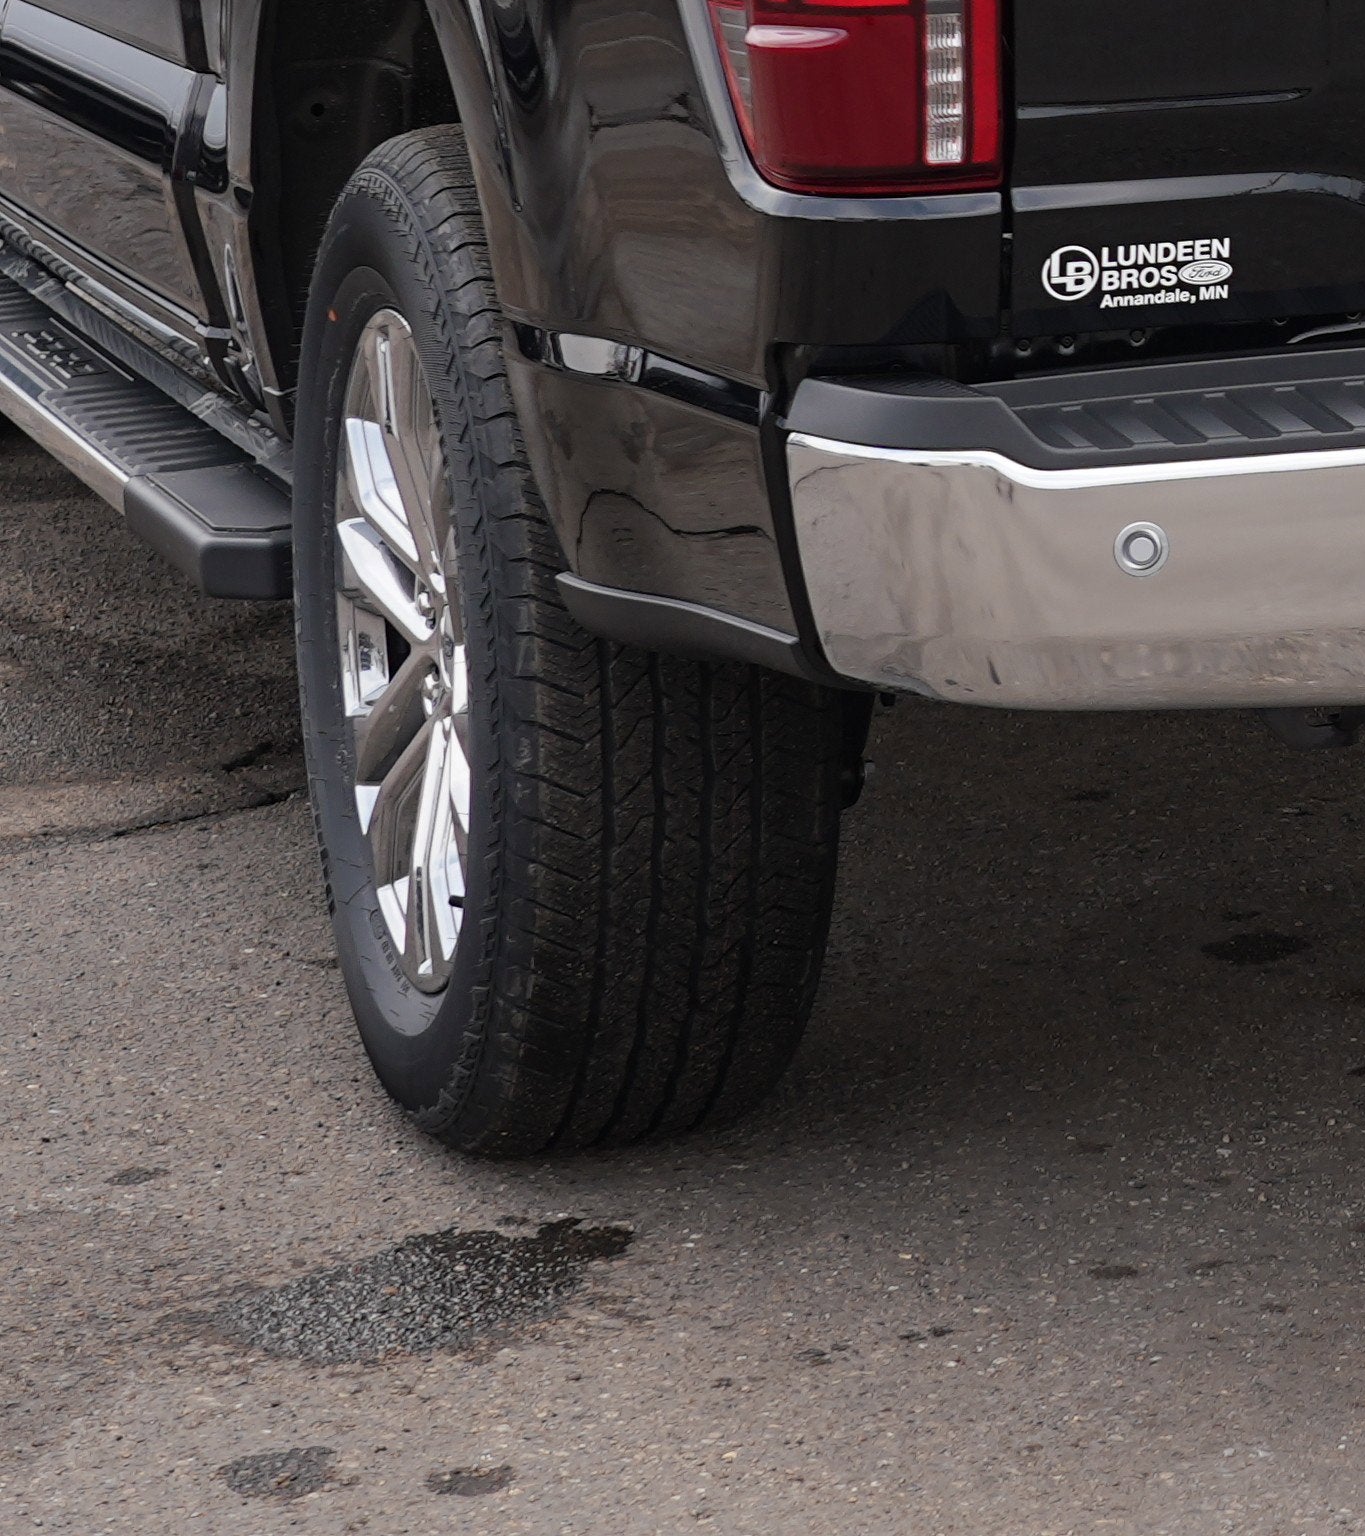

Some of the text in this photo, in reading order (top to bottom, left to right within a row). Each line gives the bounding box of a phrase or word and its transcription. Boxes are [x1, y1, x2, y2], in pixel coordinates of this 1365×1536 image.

[1101, 237, 1230, 267] LUNDEEN
[1101, 265, 1178, 291] BROS
[1100, 284, 1229, 309] Annandale, MN
